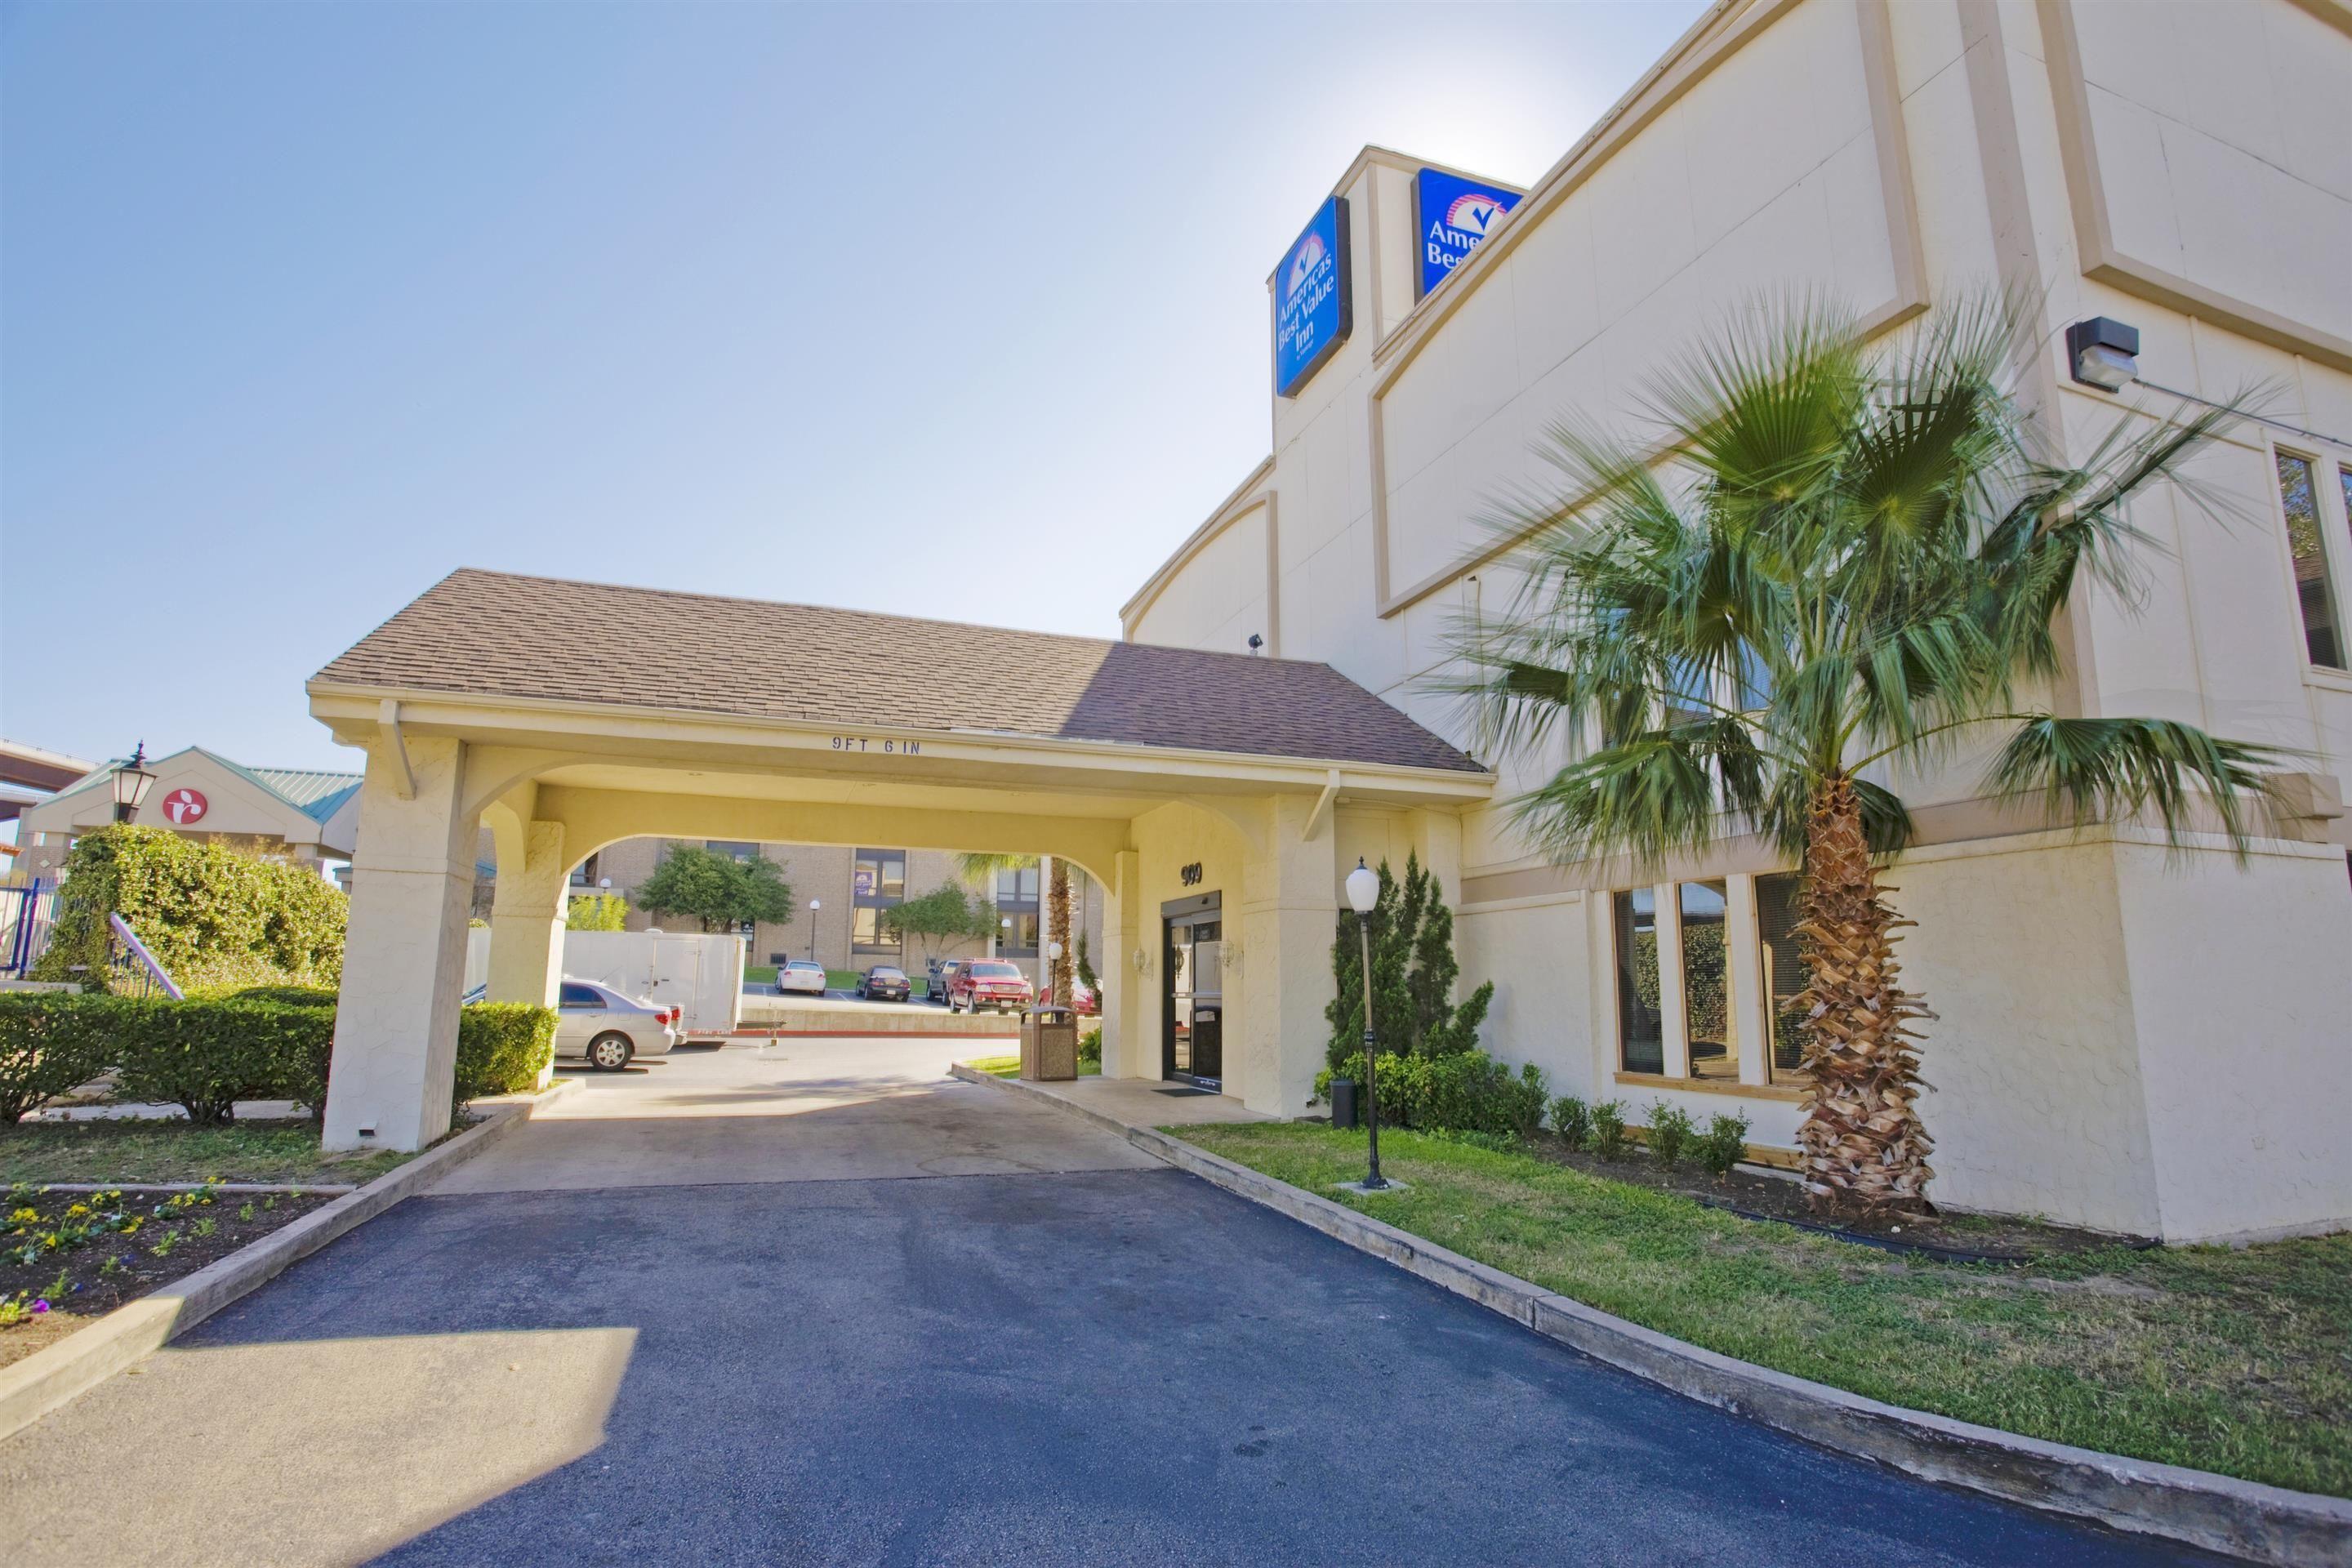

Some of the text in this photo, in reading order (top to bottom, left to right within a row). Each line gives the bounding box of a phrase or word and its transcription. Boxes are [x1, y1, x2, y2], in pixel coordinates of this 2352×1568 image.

[1278, 313, 1300, 352] Best
[1302, 275, 1334, 319] Value
[1279, 252, 1332, 327] Americas
[1295, 321, 1314, 352] Inn
[903, 741, 920, 755] IN
